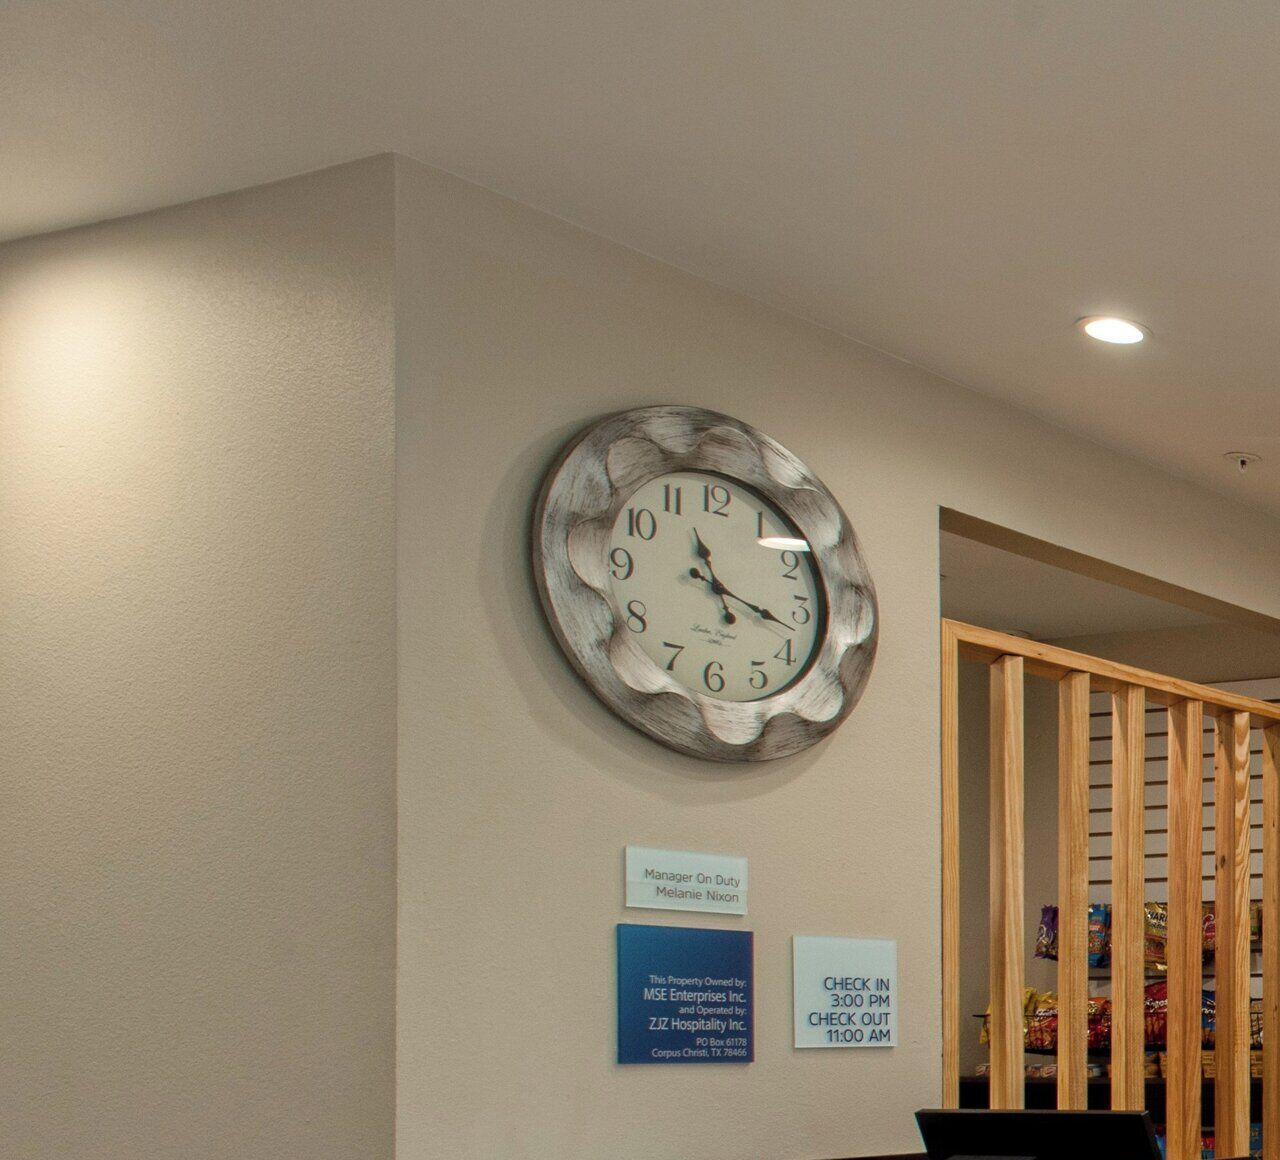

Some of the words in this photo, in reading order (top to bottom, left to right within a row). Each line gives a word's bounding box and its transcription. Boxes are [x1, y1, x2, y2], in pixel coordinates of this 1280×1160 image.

[663, 483, 682, 515] 11
[702, 484, 731, 517] 12
[626, 507, 656, 540] 10
[756, 511, 764, 538] 1
[610, 547, 634, 580] 9
[781, 551, 800, 580] 2
[626, 600, 647, 633] 8
[792, 595, 810, 625] 3
[663, 641, 685, 671] 7
[773, 638, 797, 665] 4
[703, 661, 725, 692] 6
[748, 660, 768, 689] 5
[645, 868, 693, 884] Manager
[696, 872, 712, 884] On
[715, 874, 740, 889] Duty
[656, 886, 703, 900] Melanie
[706, 890, 739, 903] Nixon
[649, 975, 666, 985] This
[668, 976, 702, 987] Property
[704, 977, 734, 986] Owned
[735, 978, 747, 989] by:
[824, 976, 871, 991] CHECK
[876, 978, 890, 991] IN
[643, 988, 668, 1000] MSE
[670, 988, 727, 1004] Enterprises
[729, 991, 747, 1003] Inc.
[831, 993, 864, 1008] 3:00
[869, 994, 890, 1008] PM
[679, 1006, 695, 1014] and
[696, 1005, 734, 1016] Operated
[735, 1006, 747, 1016] by:
[808, 1012, 856, 1026] CHECK
[861, 1012, 891, 1026] OUT
[649, 1017, 669, 1030] ZJZ
[671, 1018, 727, 1033] Hospitality
[729, 1019, 747, 1031] Inc.
[827, 1028, 864, 1042] 11:00
[869, 1029, 891, 1042] AM
[652, 1048, 681, 1059] Corpus
[711, 1048, 722, 1057] TX
[696, 1038, 708, 1046] PO
[710, 1038, 725, 1046] Box
